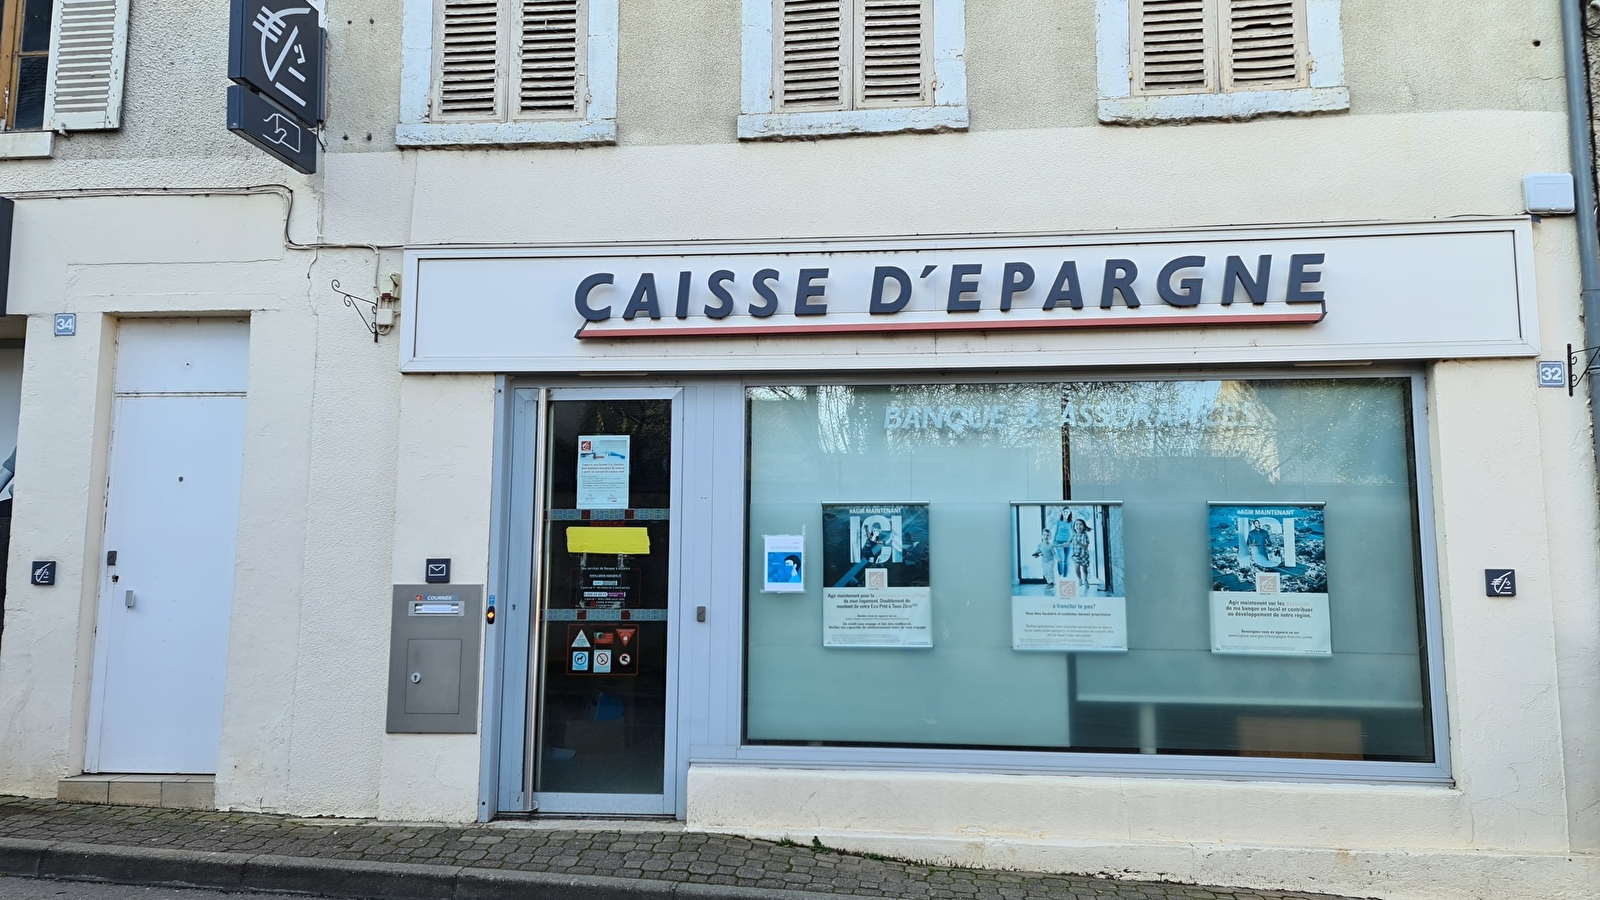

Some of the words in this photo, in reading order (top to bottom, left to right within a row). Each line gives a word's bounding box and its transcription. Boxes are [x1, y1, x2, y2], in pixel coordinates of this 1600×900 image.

[574, 267, 829, 321] CAISSE
[57, 318, 73, 330] 34
[1541, 367, 1562, 381] 32
[884, 405, 1007, 434] BANQUE
[1058, 401, 1257, 428] ASSURANCES
[850, 515, 903, 563] ICI
[1237, 517, 1296, 567] ICI
